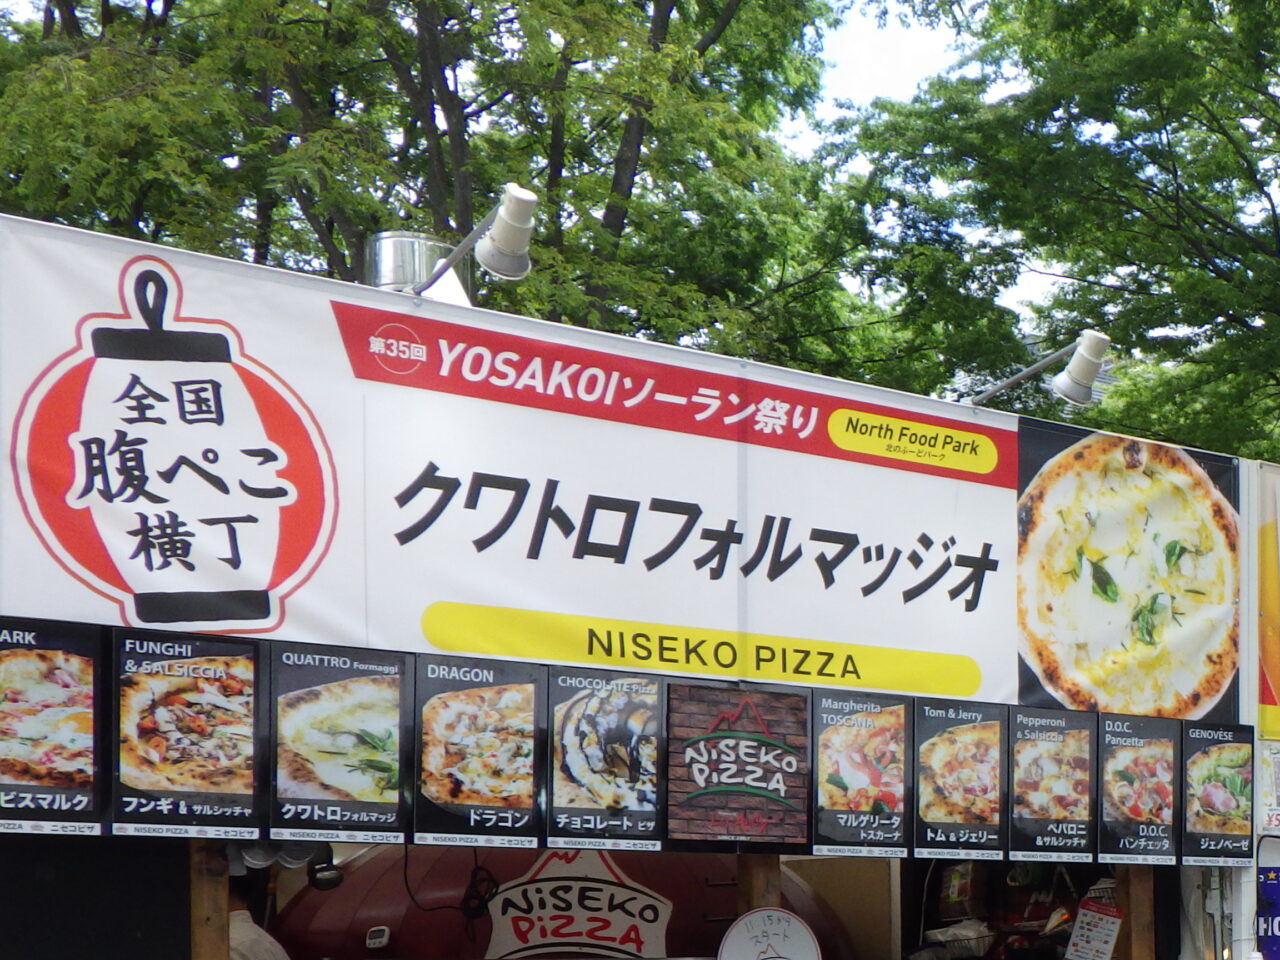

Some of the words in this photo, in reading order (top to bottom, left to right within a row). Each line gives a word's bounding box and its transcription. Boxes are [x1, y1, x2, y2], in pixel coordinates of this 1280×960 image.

[369, 335, 427, 362] 第35回
[437, 339, 819, 439] YOSAKOIソーラン祭り
[113, 374, 224, 427] 全国
[845, 417, 893, 440] North
[898, 426, 938, 448] Food
[942, 436, 980, 456] Park
[76, 430, 289, 504] 腹ぺこ
[127, 511, 258, 572] 横丁
[394, 461, 998, 613] クワトロフォルマッジオ
[125, 640, 191, 657] FUNGHI
[586, 627, 737, 669] NISEKO
[754, 644, 862, 680] PIZZA
[125, 659, 138, 673] &
[139, 661, 227, 680] SALSICCIA
[282, 653, 350, 669] QUATTRO
[353, 661, 398, 674] Formaggi
[427, 664, 494, 683] DRAGON
[558, 676, 631, 692] CHOCOLATE
[631, 684, 656, 694] Pizza
[821, 698, 881, 715] Margherita
[924, 706, 944, 718] Tom
[947, 708, 956, 719] &
[958, 710, 982, 723] Jerry
[821, 714, 875, 729] TOSCANA
[1016, 714, 1065, 729] Pepperoni
[1105, 721, 1132, 733] D.O.C.
[1024, 730, 1064, 743] Salsiccia
[1105, 734, 1143, 748] Pancetta
[122, 796, 174, 815] フンギ
[178, 801, 188, 815] &
[469, 809, 529, 828] ドラゴン
[556, 814, 633, 831] チョコレート
[836, 814, 901, 829] マルゲリータ
[134, 826, 164, 834] NISEKO
[318, 832, 340, 840] PIZZA
[860, 830, 901, 841] トスカーナ
[927, 829, 947, 842] トム
[949, 833, 956, 842] &
[958, 830, 998, 843] ジェリー
[1139, 825, 1168, 837] D.O.C.
[458, 836, 479, 844] PIZZA
